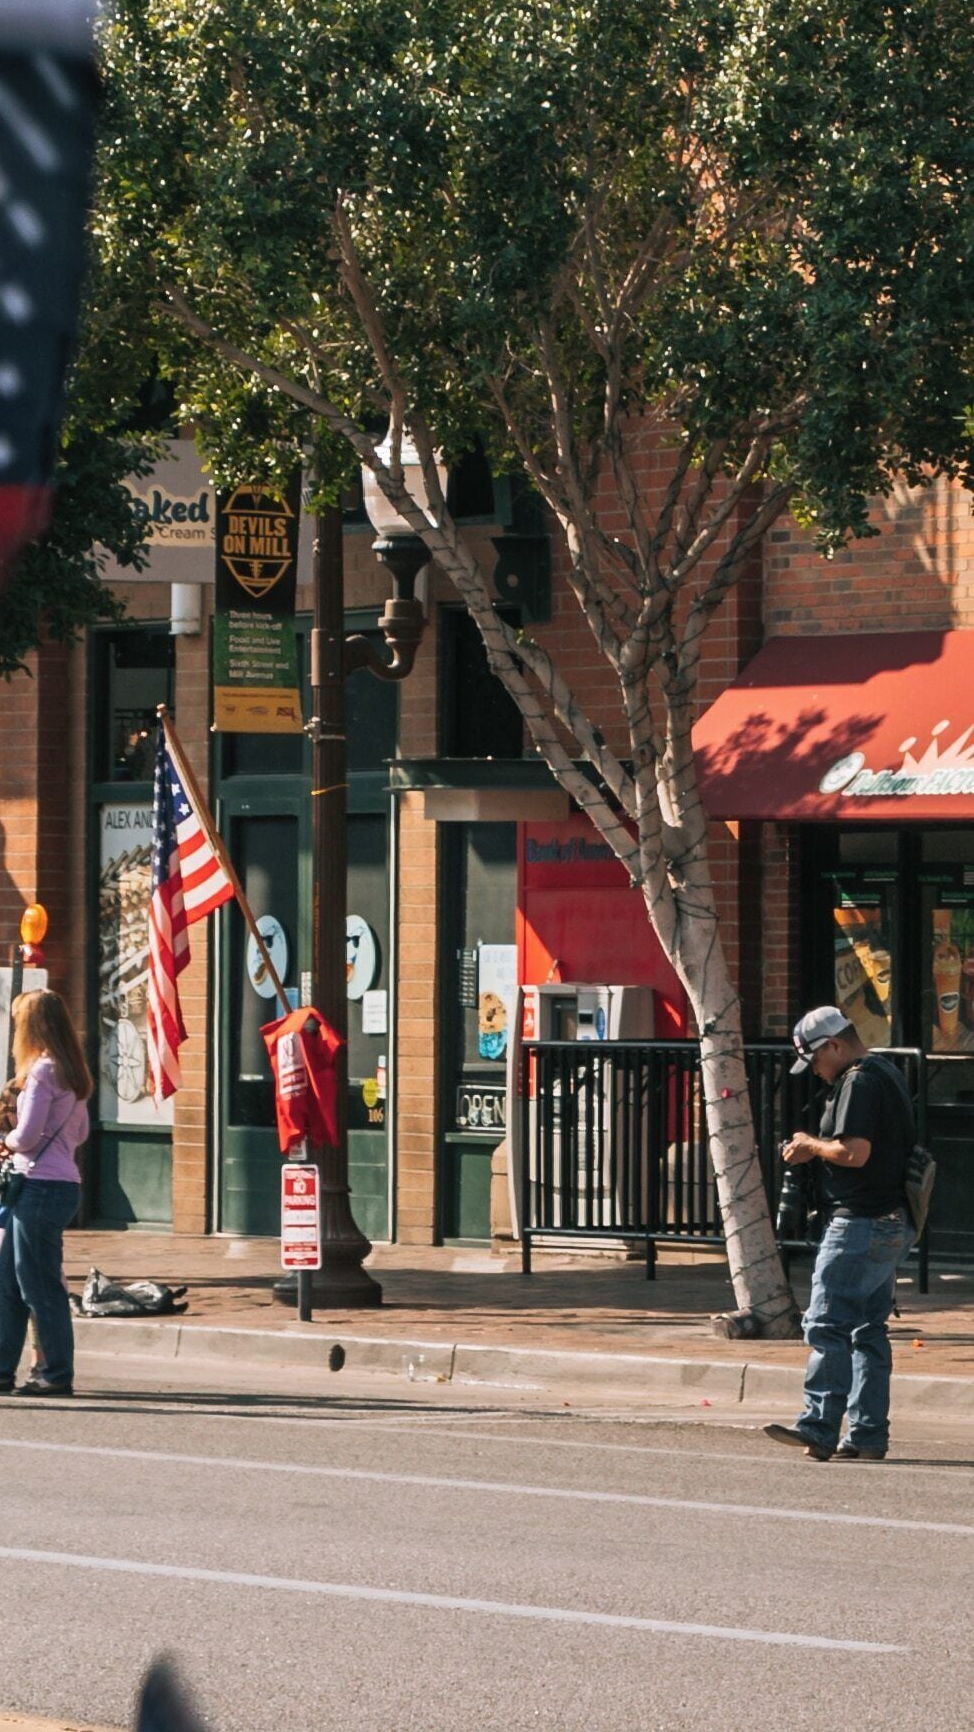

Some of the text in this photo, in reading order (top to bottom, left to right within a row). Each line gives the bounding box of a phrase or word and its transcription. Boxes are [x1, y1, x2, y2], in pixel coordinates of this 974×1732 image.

[114, 485, 210, 525] aked
[228, 515, 286, 537] DEVILS
[223, 534, 291, 557] ON MILL
[105, 810, 131, 829] ALEX
[368, 1108, 385, 1123] 106
[460, 1094, 506, 1126] OPEN
[292, 1180, 307, 1195] NO
